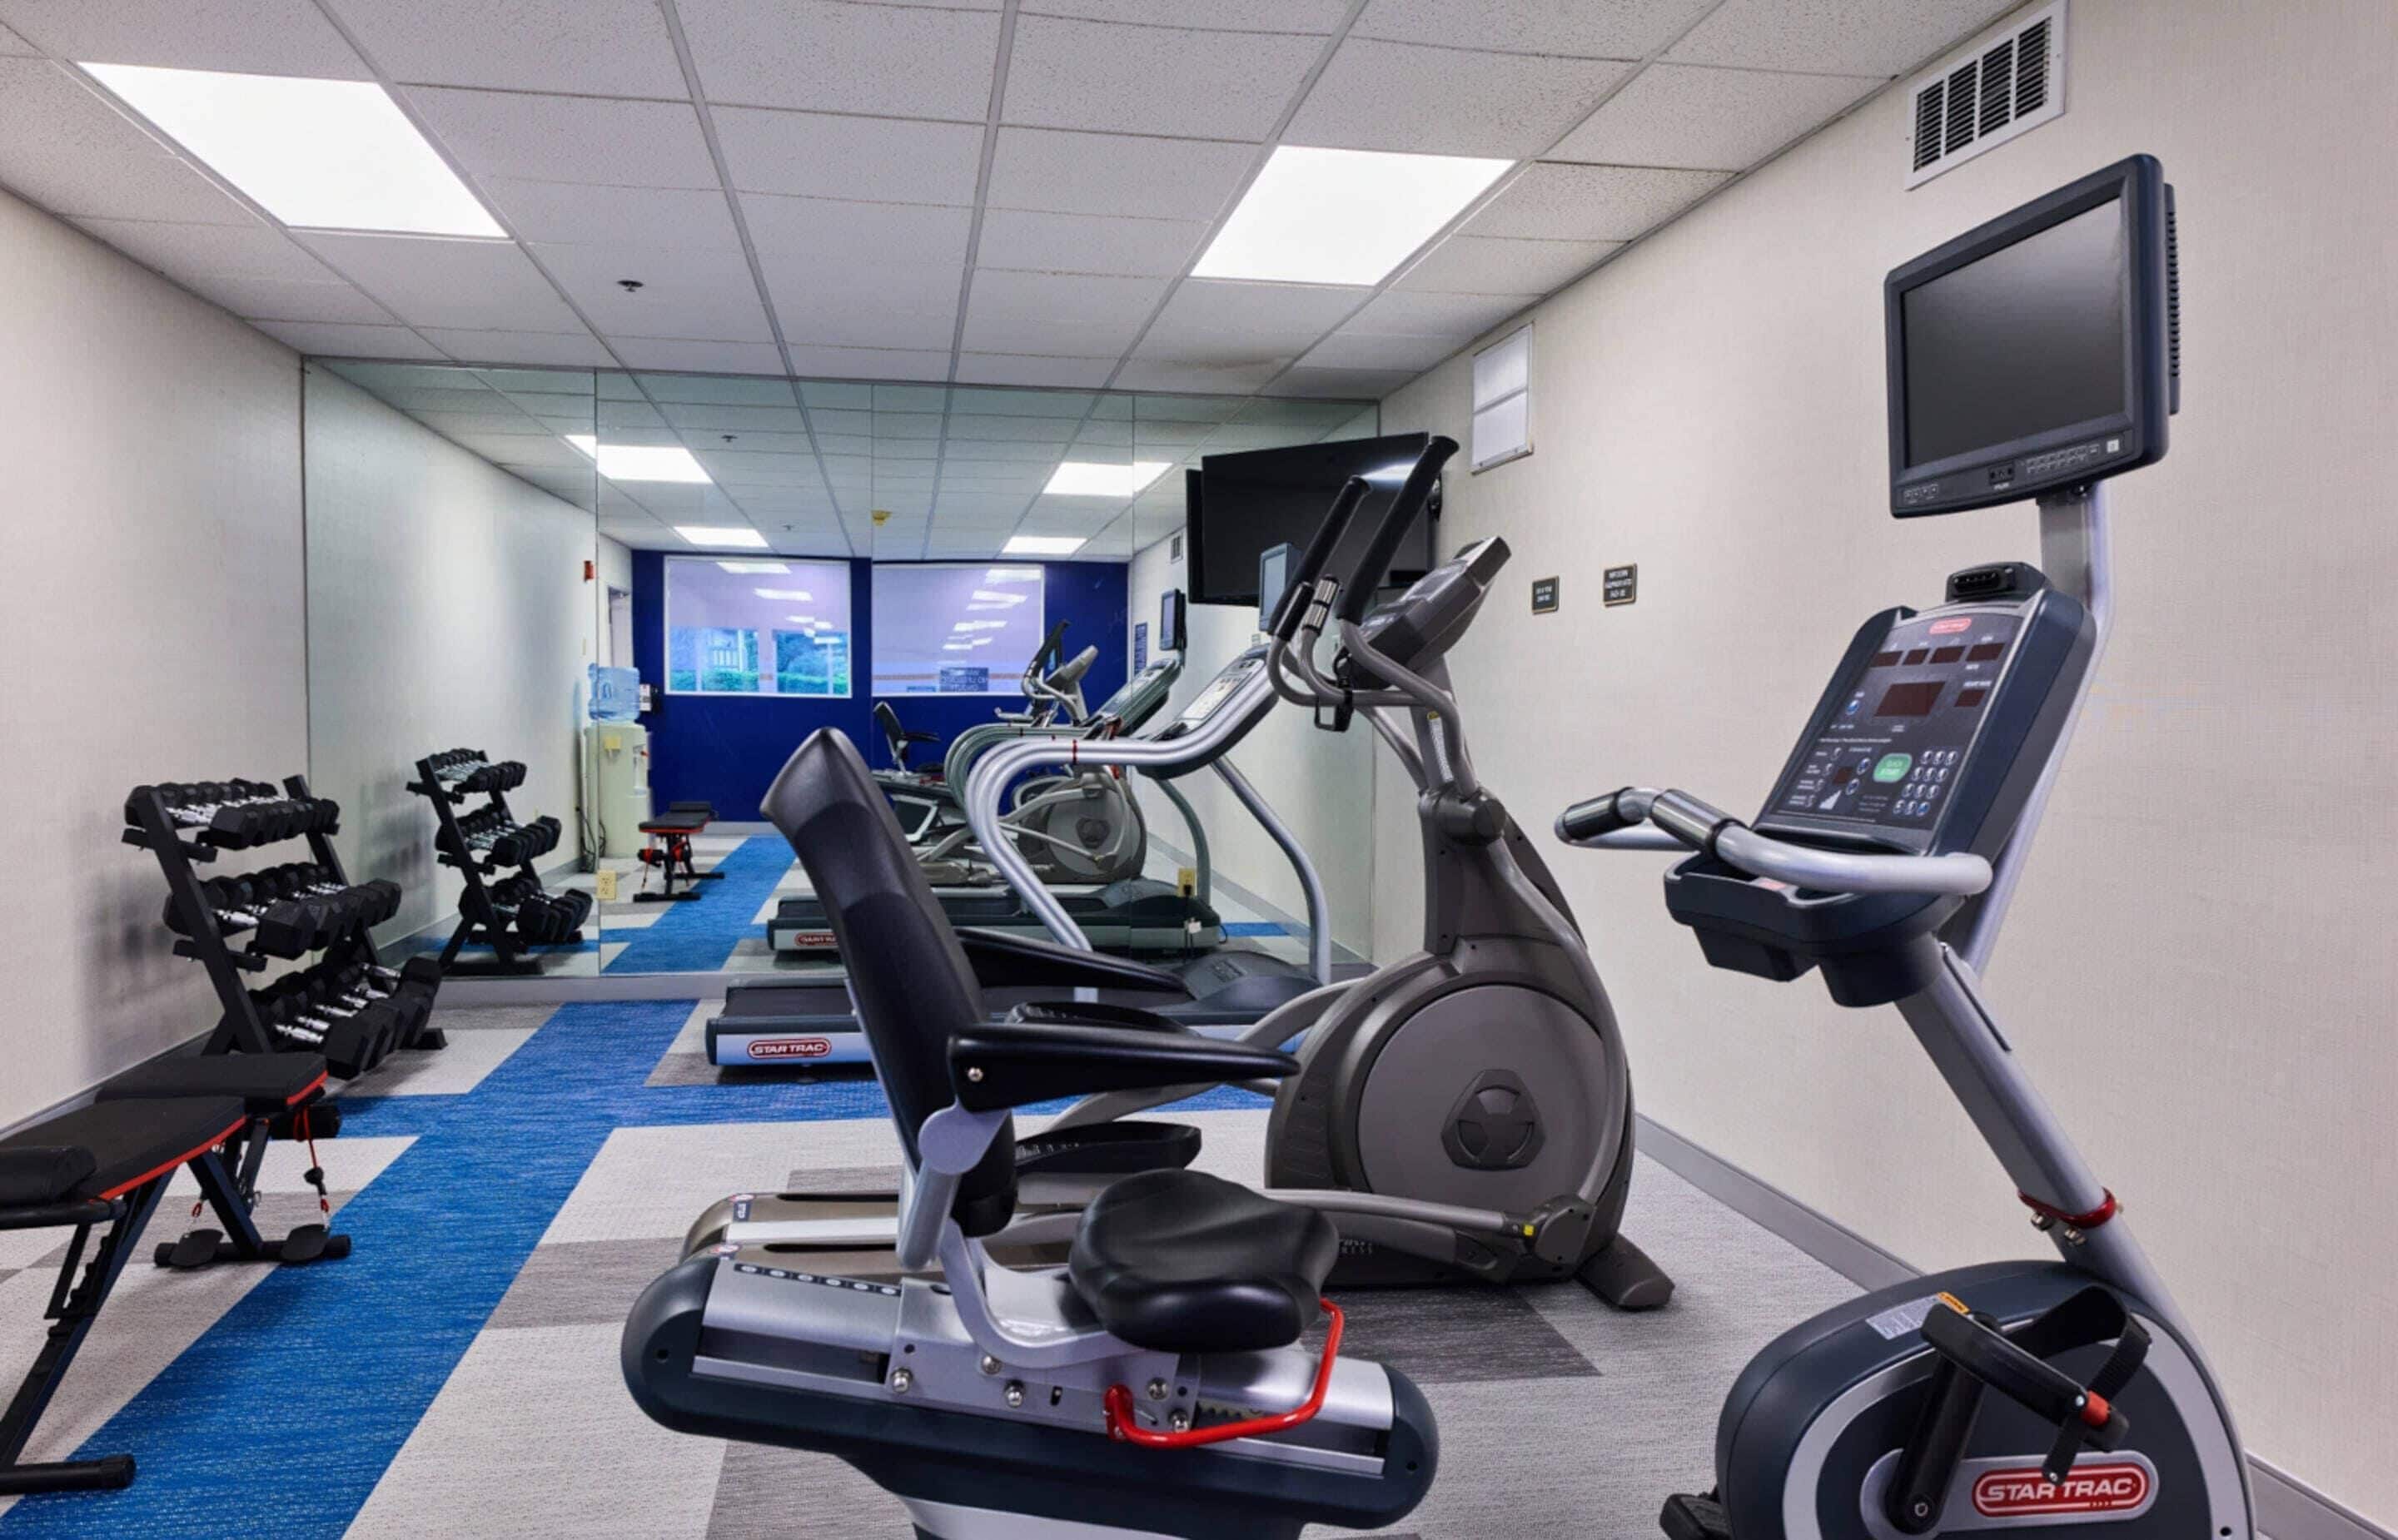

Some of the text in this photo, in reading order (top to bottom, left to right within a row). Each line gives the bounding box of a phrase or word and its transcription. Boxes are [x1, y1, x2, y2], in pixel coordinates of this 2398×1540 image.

[754, 1044, 823, 1055] STAR TRAC
[1986, 1478, 2134, 1502] STAR TRAC
